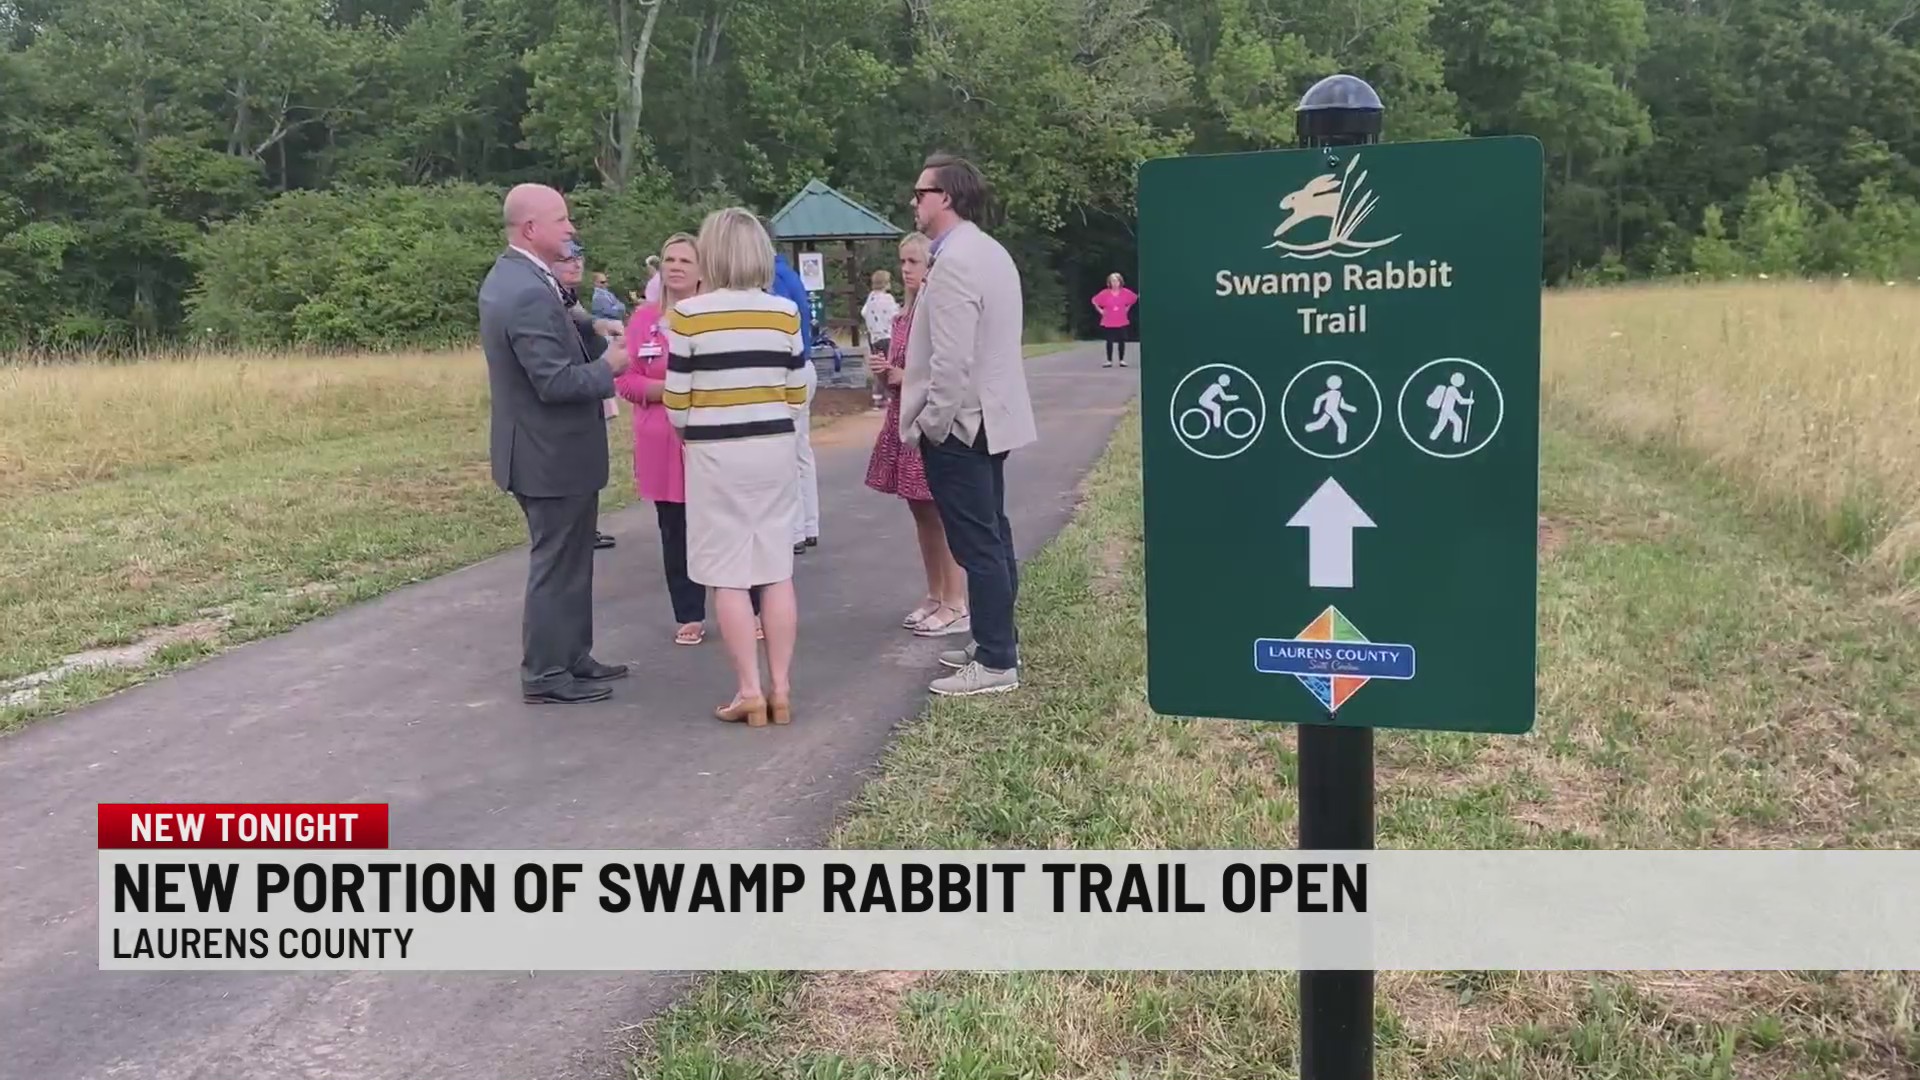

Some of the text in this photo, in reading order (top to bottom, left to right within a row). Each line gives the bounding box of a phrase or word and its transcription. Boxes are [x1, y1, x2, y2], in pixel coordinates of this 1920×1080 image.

[1215, 260, 1453, 298] Swamp Rabbit
[1297, 305, 1367, 334] Trail
[1269, 646, 1400, 663] LAURENS COUNTY
